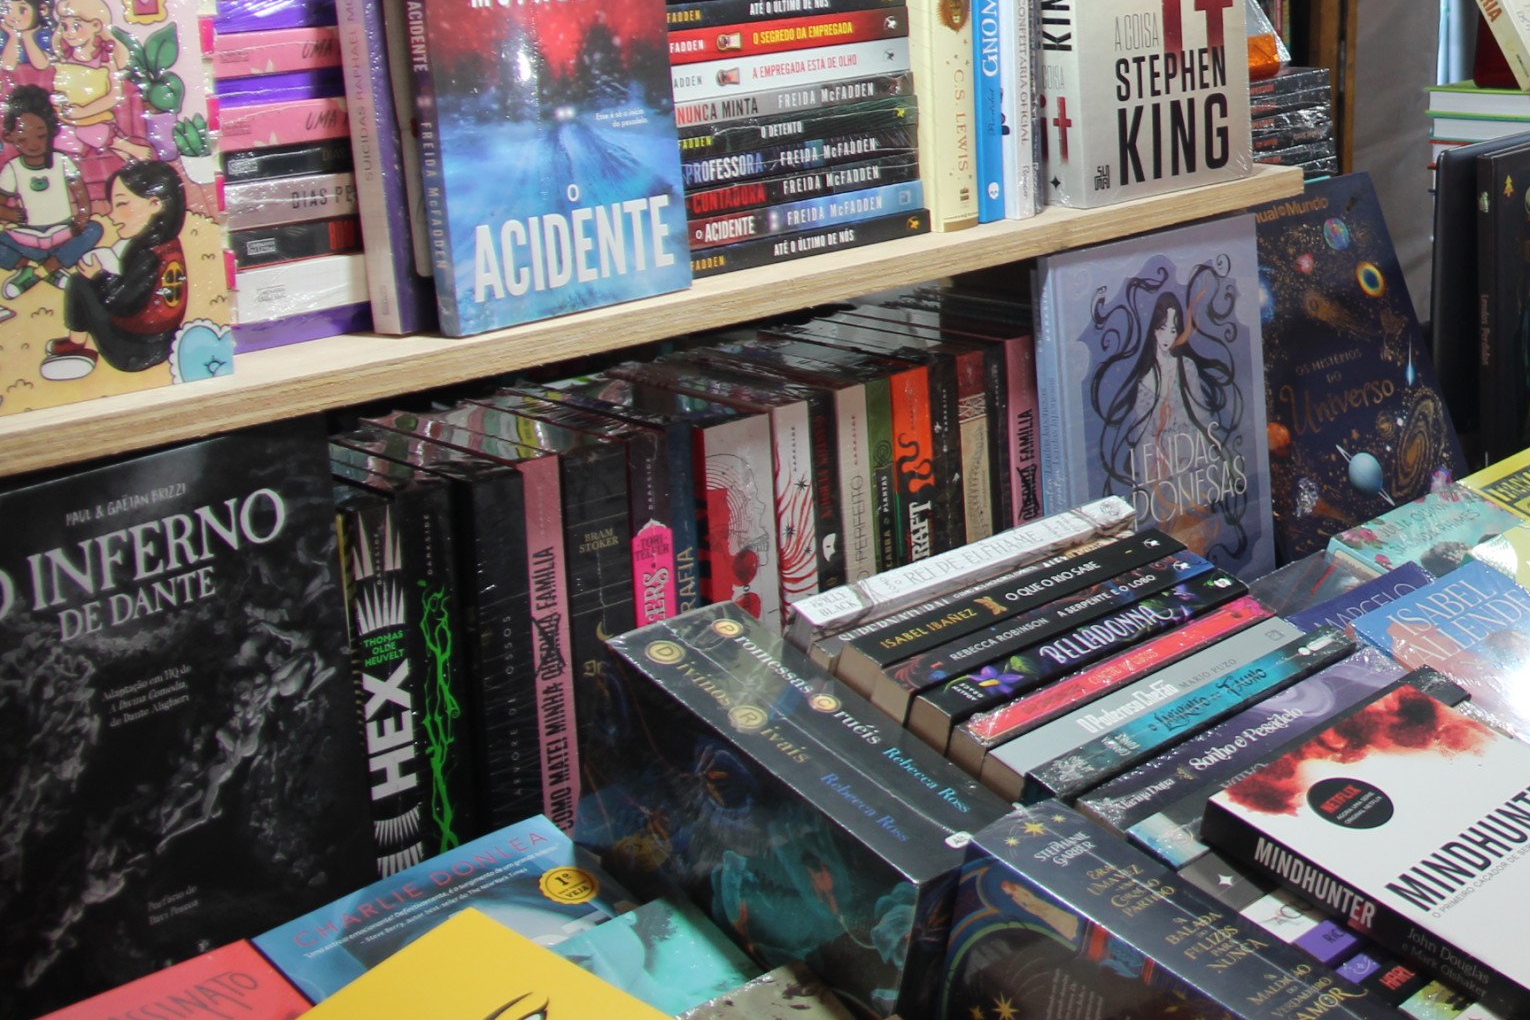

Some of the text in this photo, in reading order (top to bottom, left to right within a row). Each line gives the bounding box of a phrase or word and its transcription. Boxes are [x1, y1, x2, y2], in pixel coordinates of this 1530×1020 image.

[761, 22, 853, 44] SEGREDO EMPREGADA
[760, 61, 806, 78] EMPREGADA
[1115, 45, 1227, 103] STEPHEN
[778, 83, 875, 109] FREIDA McFADDEN
[406, 0, 448, 270] ACIDENTE FREIDA McFADDEN
[780, 139, 876, 167] FREIDA McFADDEN
[954, 111, 970, 179] LEWIS
[1117, 92, 1231, 187] KING
[566, 183, 581, 203] O
[783, 174, 821, 195] FREIDA
[704, 196, 883, 242] ACIDENTE FREIDA McFADDEN
[473, 193, 676, 305] ACIDENTE
[798, 236, 825, 252] ÚLTIMO
[1279, 379, 1395, 436] Universo
[1017, 408, 1035, 461] FAMÍLIA
[1129, 421, 1223, 486] LENDAS
[65, 483, 187, 527] PAUL BRIZZI
[26, 487, 287, 614] INFERNO
[578, 536, 620, 554] STOKER
[584, 528, 615, 543] BRAM
[903, 559, 965, 587] REI DE
[1130, 574, 1157, 591] LOBO
[58, 566, 217, 644] DE DANTE
[880, 626, 928, 650] ISABEL
[1017, 582, 1044, 599] QUE
[1073, 561, 1102, 579] SABE
[1386, 579, 1498, 637] ISABEL
[363, 629, 404, 650] THOMAS
[372, 641, 398, 657] OLDE
[1039, 605, 1174, 666] BELLADONNA
[364, 647, 406, 669] HEUVELT
[1177, 671, 1210, 689] MARIO
[1210, 658, 1238, 677] PUZO
[361, 657, 419, 802] HEX
[711, 618, 972, 815] Promessas Cruéis Ross
[1188, 707, 1306, 771] Sonho Pesadelo
[819, 772, 910, 844] Rebecca Ross
[1319, 784, 1362, 813] NETFLIX
[1034, 830, 1091, 863] STEPHANIE
[1053, 840, 1097, 867] GARBER
[293, 830, 550, 950] CHARLIE DONLEA
[564, 884, 592, 900] VEJA
[1254, 837, 1377, 929] MINDHUNTER
[1433, 942, 1490, 983] Douglas
